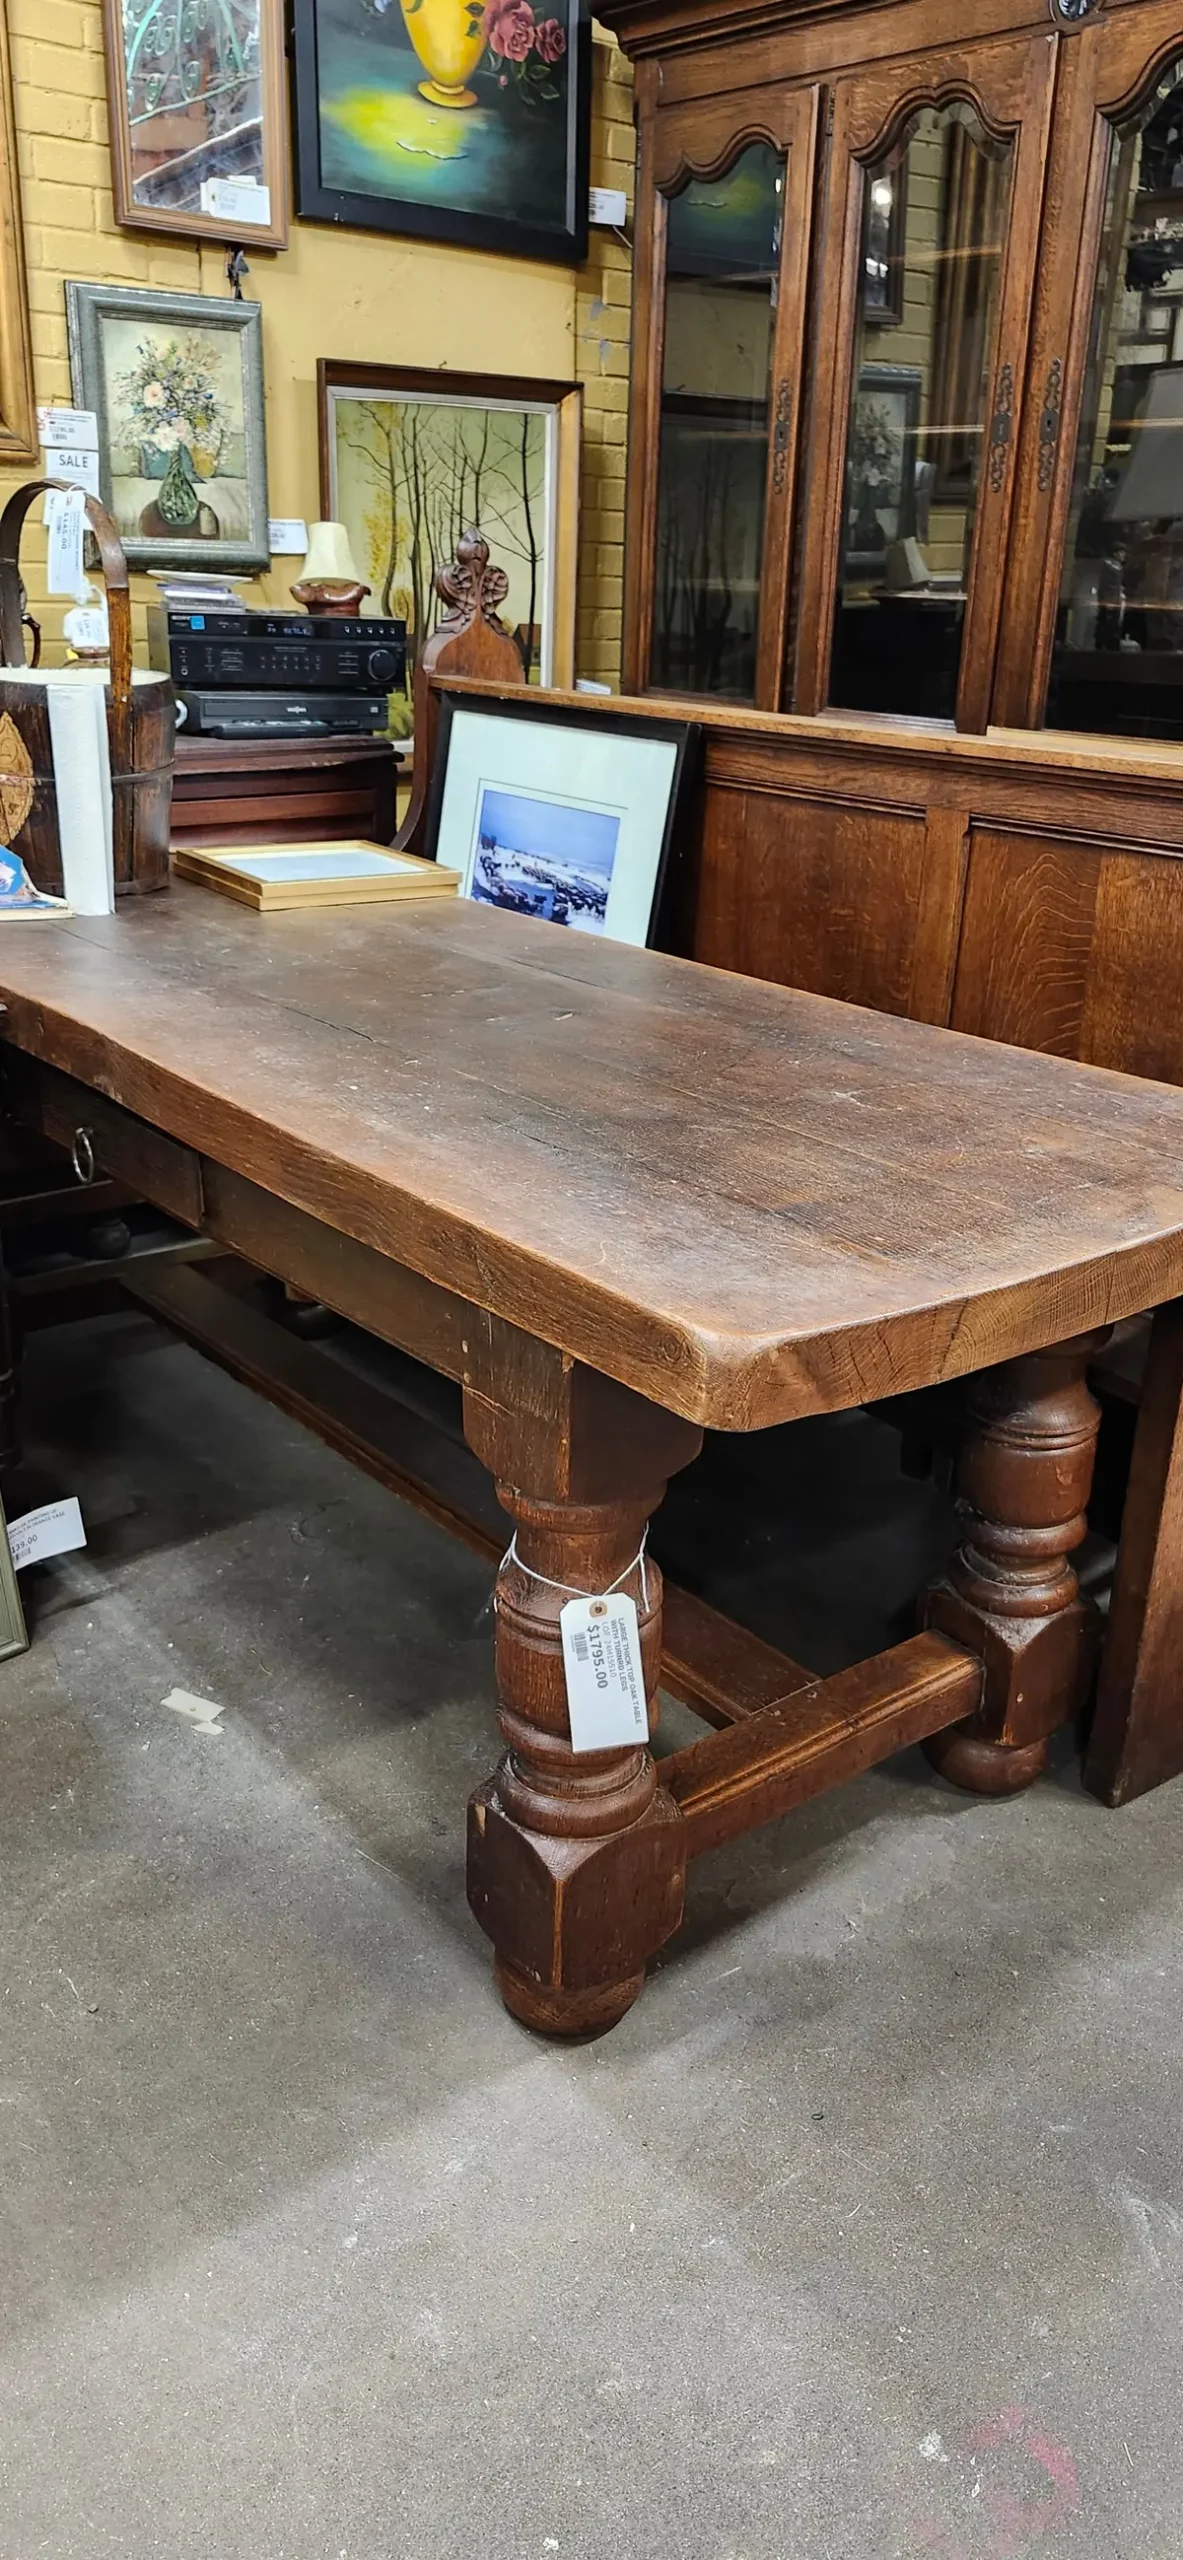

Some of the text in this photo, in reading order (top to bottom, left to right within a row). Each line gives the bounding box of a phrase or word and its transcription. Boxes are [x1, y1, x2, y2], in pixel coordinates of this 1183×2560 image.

[59, 454, 89, 468] SALE
[587, 1624, 609, 1689] $1795.00
[611, 1618, 619, 1639] WITH
[619, 1671, 628, 1692] LEGS
[618, 1617, 642, 1725] LARGE THICK TOP OAK TABLE
